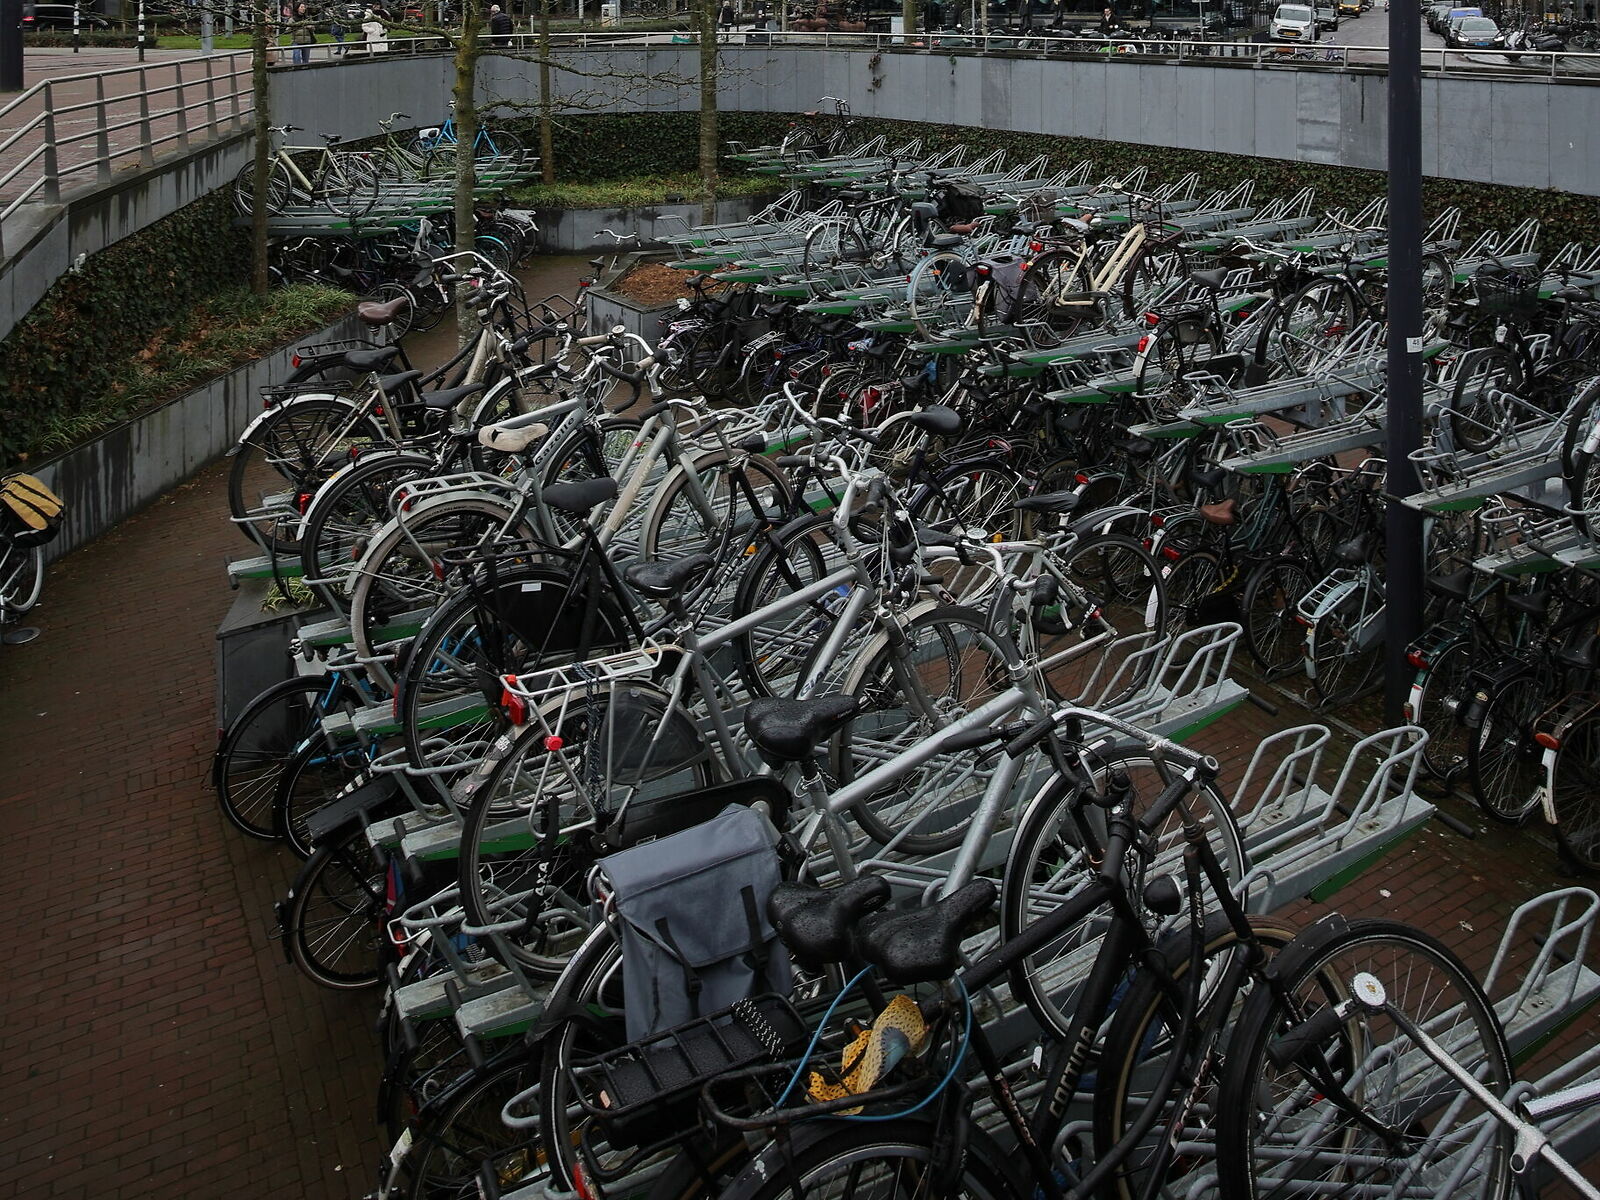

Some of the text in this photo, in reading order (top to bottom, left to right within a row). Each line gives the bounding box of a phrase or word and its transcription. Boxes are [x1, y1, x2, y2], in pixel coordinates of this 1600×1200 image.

[534, 416, 575, 466] Gazelle
[700, 557, 739, 614] Gazelle
[535, 861, 550, 897] AXA
[1049, 1025, 1097, 1120] CORTINA
